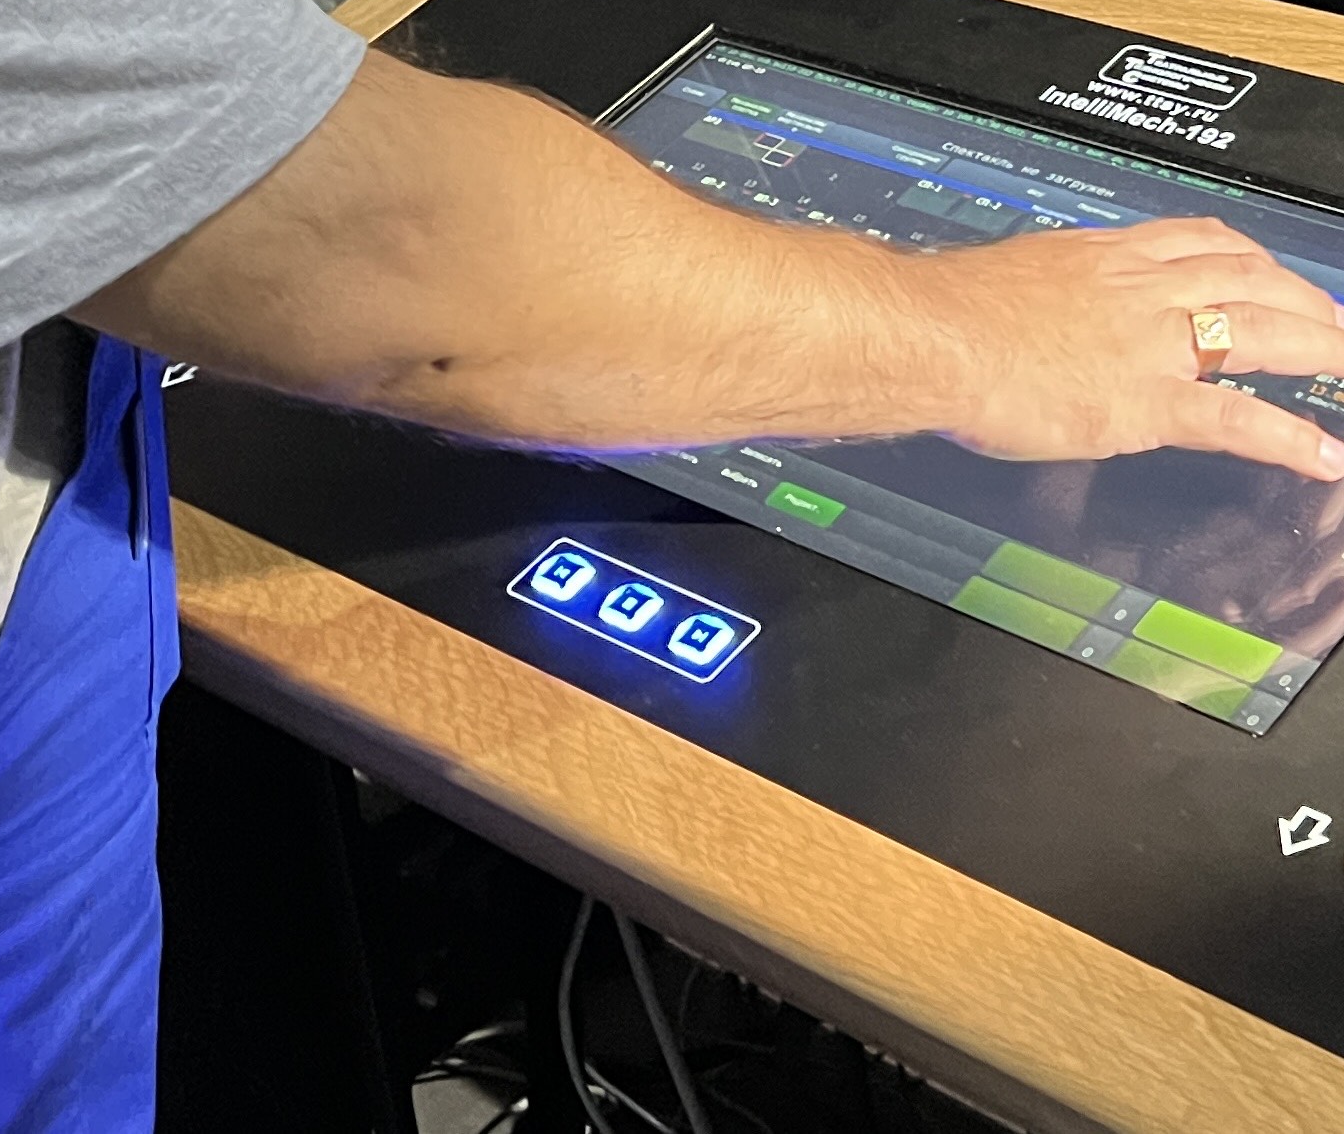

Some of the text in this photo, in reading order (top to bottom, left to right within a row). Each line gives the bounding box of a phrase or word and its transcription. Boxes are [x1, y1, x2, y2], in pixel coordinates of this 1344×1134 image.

[1038, 84, 1236, 150] IntelliMech-192
[941, 141, 1014, 170] Спектакль
[1021, 165, 1040, 177] не
[1046, 173, 1116, 199] загружен
